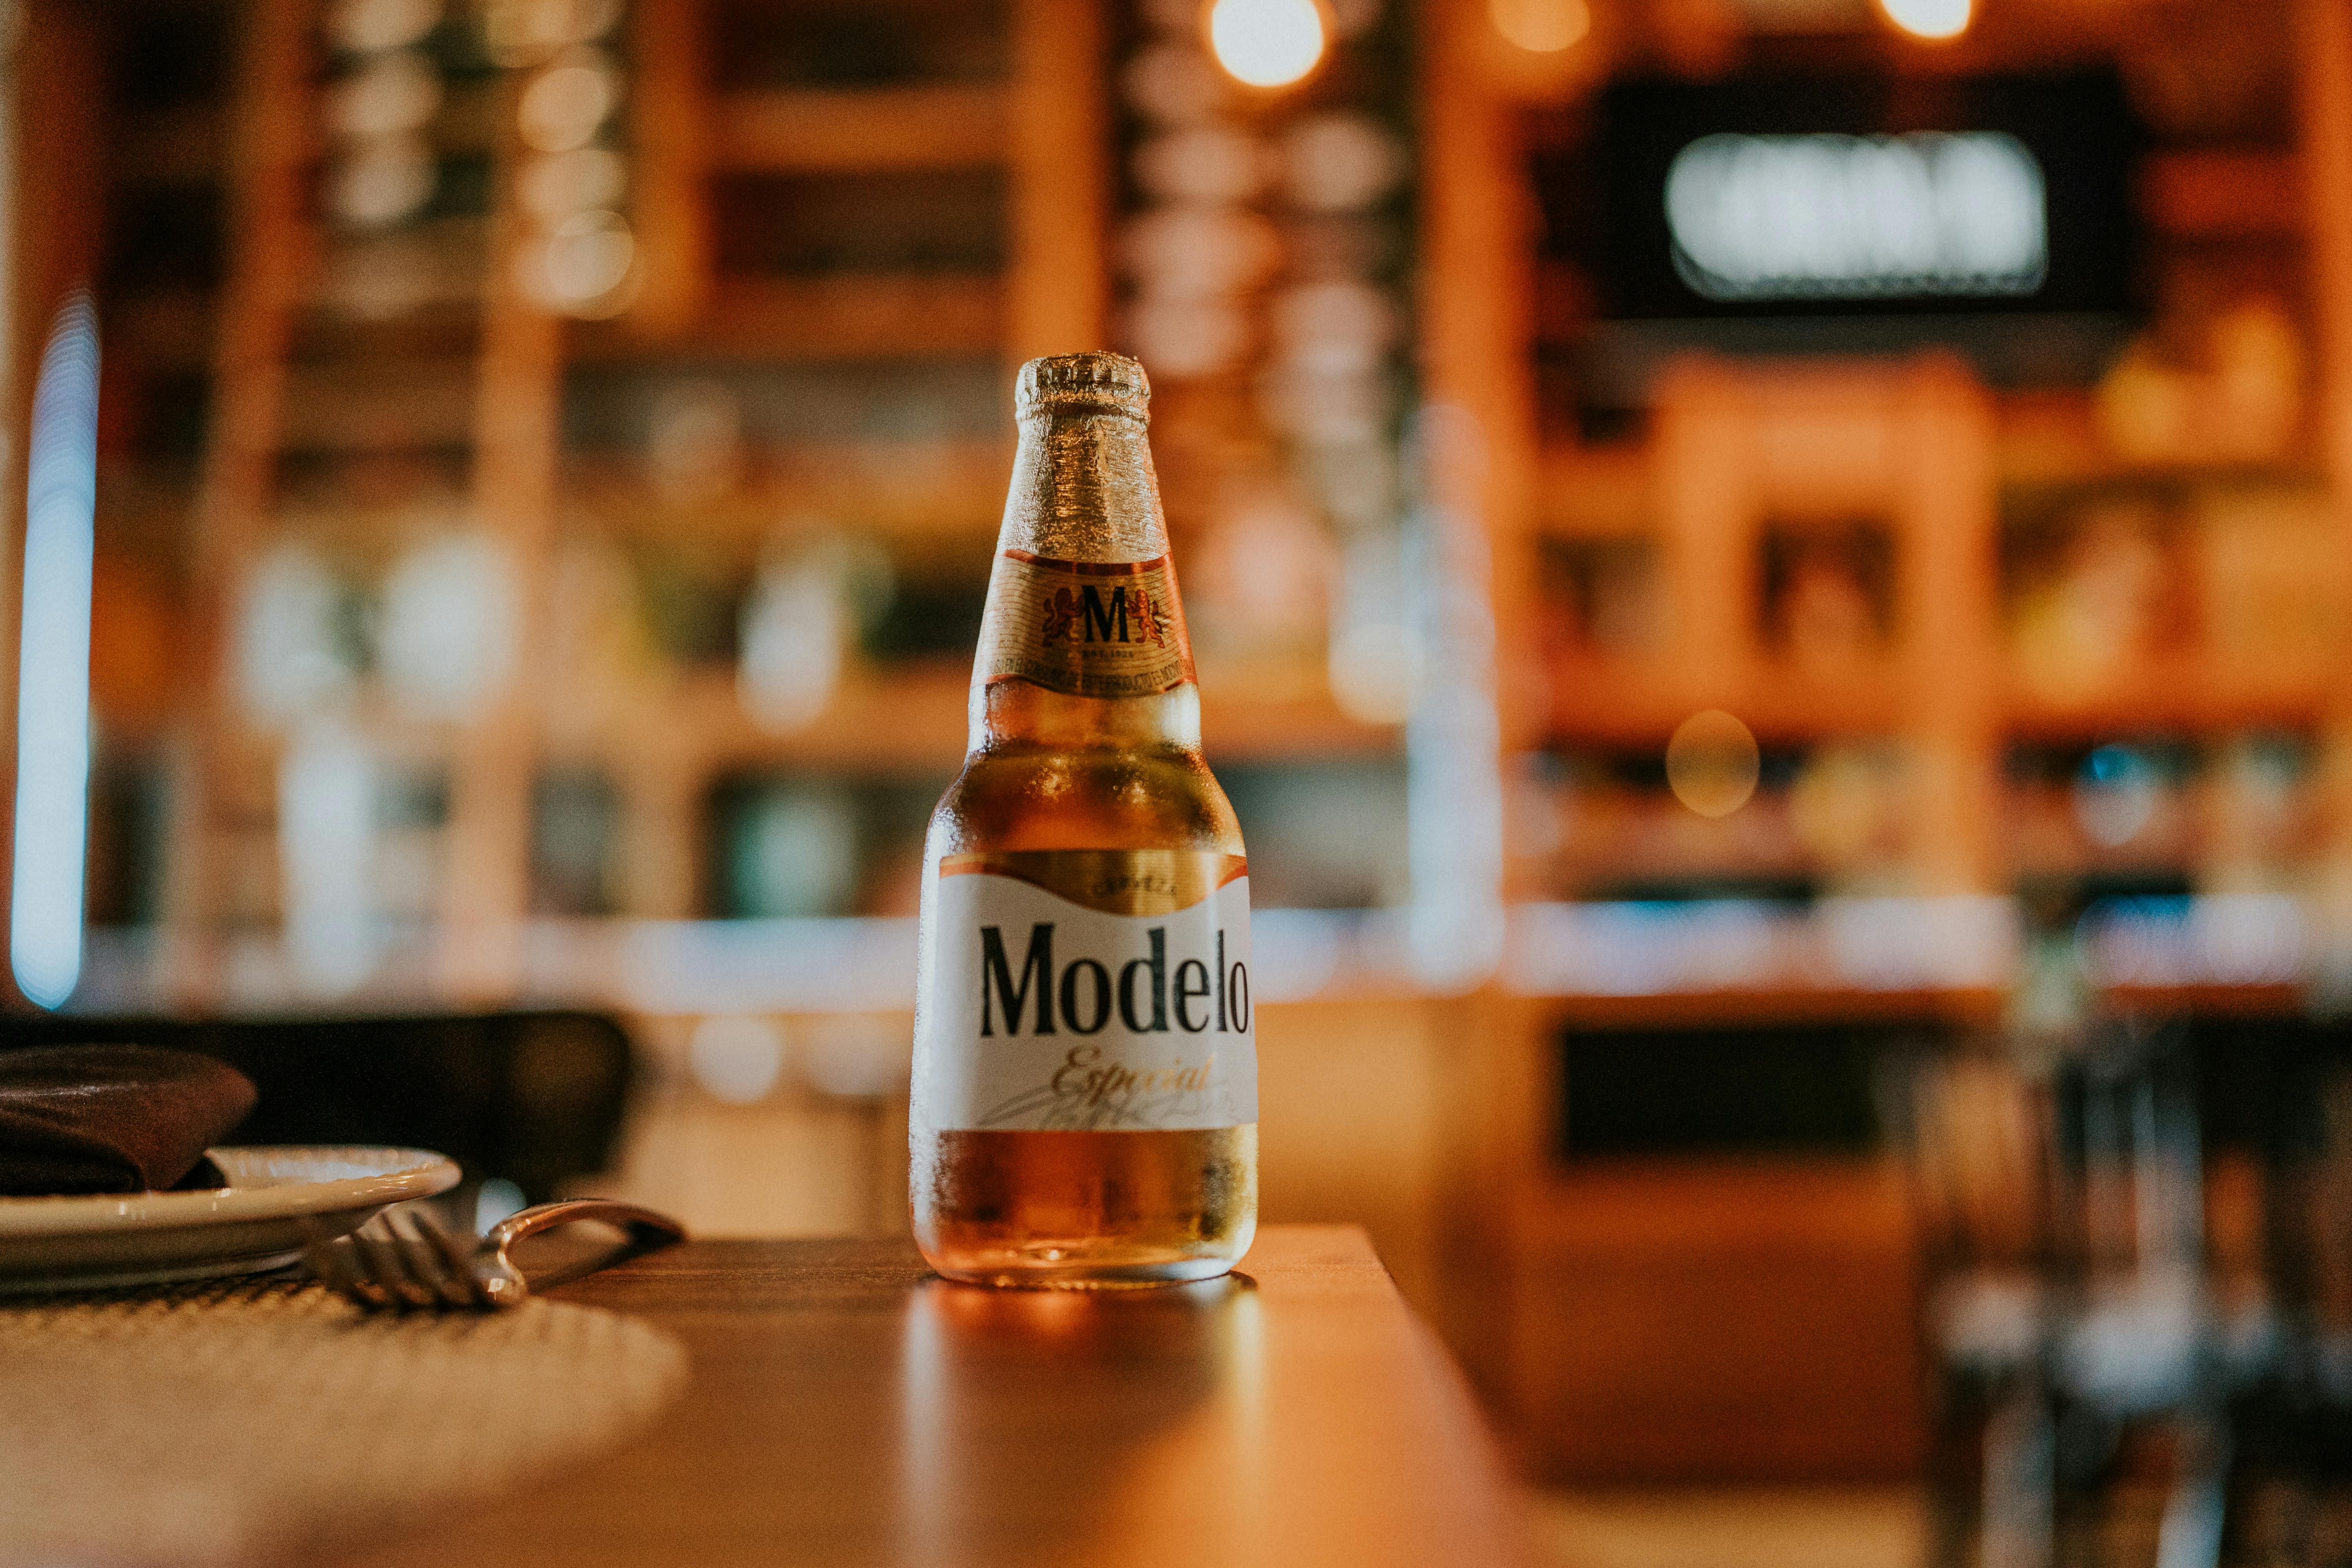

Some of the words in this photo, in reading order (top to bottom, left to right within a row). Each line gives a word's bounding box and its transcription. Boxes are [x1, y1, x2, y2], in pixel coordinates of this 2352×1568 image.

[1082, 585, 1130, 643] M
[980, 922, 1249, 1037] Modelo
[1051, 1044, 1216, 1106] Especial
